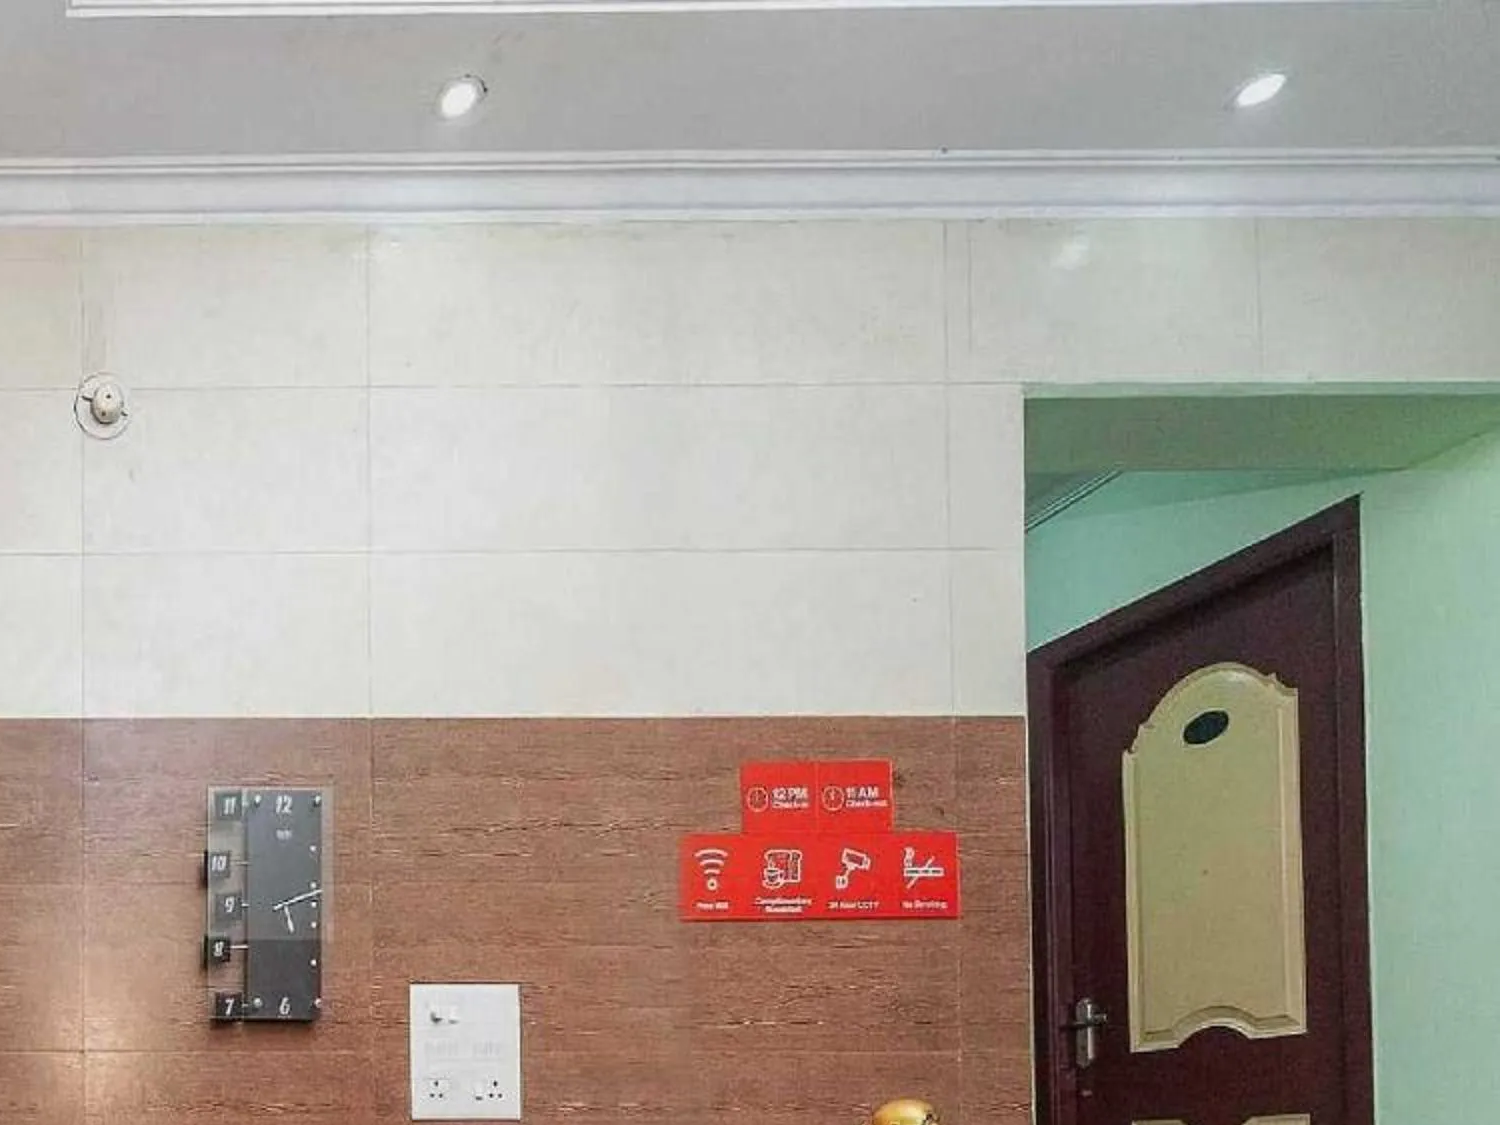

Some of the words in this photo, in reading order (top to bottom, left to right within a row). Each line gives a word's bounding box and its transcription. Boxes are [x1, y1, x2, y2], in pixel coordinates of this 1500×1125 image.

[858, 786, 880, 799] AM
[223, 798, 237, 816] 11
[275, 795, 293, 814] 12
[211, 856, 227, 872] 10
[224, 897, 235, 913] 9
[225, 999, 235, 1016] 7
[279, 997, 291, 1015] 6
